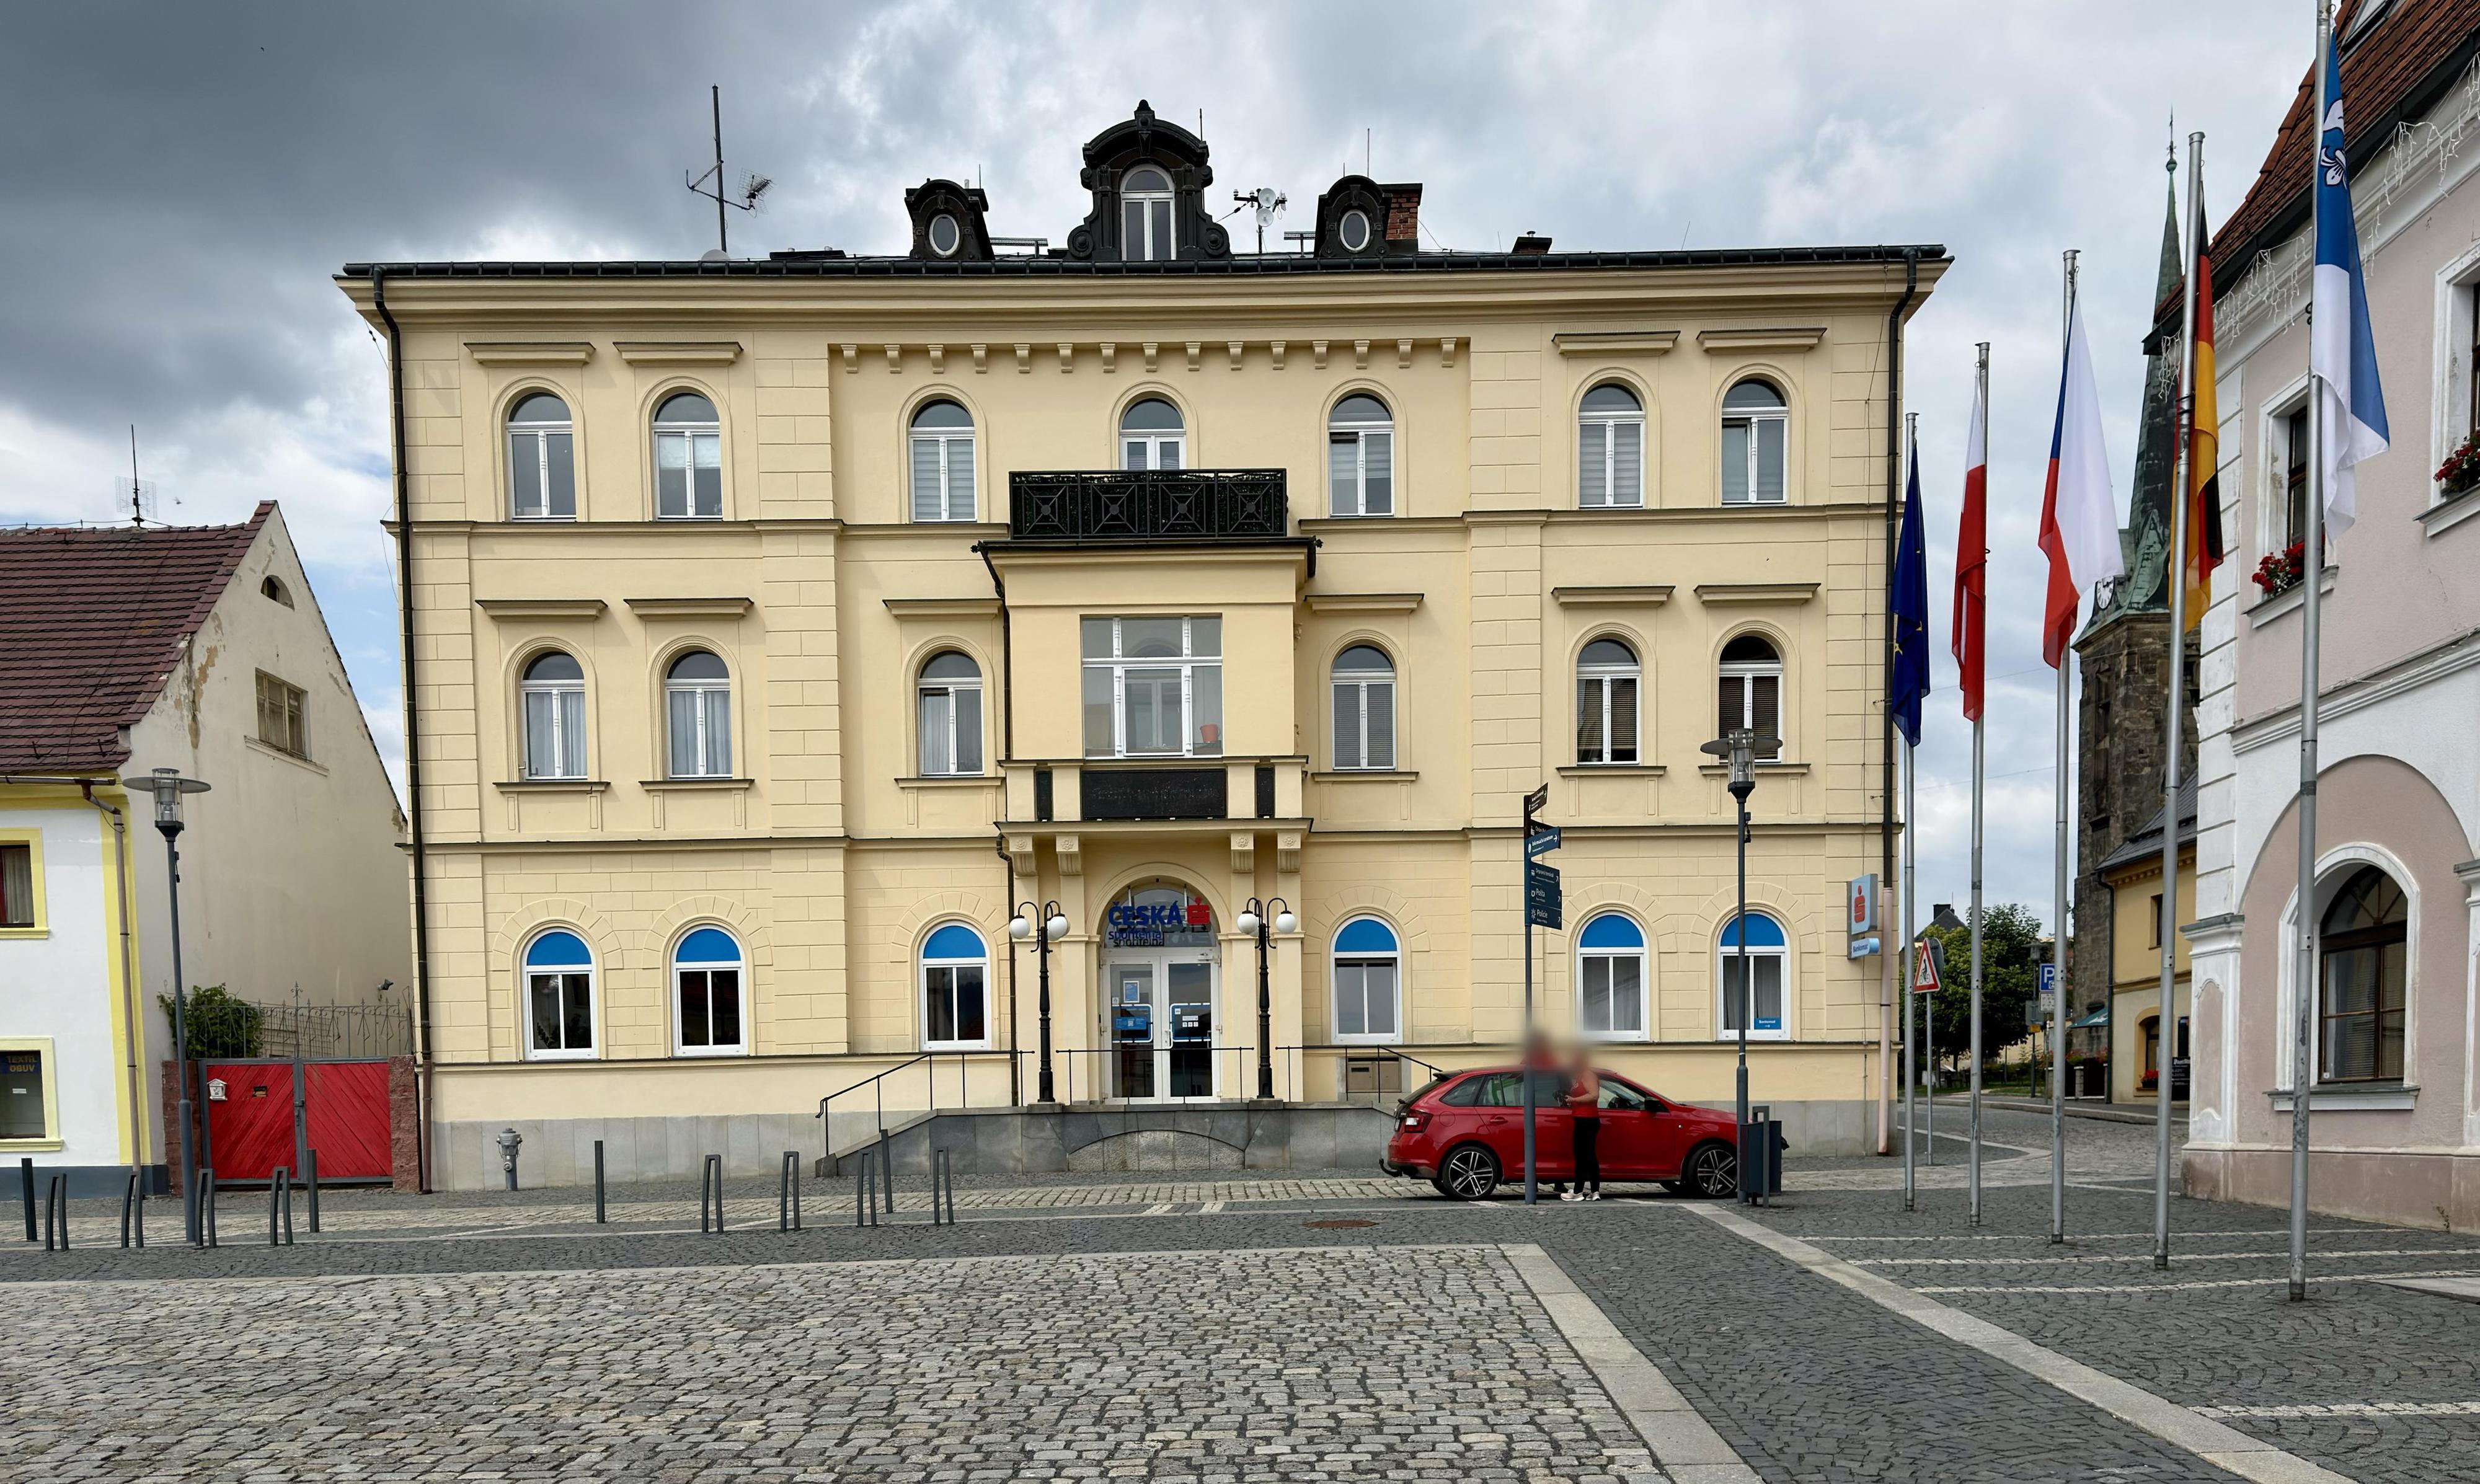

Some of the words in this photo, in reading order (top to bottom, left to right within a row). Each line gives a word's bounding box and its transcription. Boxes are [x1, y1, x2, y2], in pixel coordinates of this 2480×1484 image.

[1536, 888, 1545, 897] Pošta
[1109, 901, 1183, 926] ČESKÁ
[1537, 909, 1548, 919] Policie
[2044, 967, 2055, 983] P
[9, 1064, 35, 1072] OBUV
